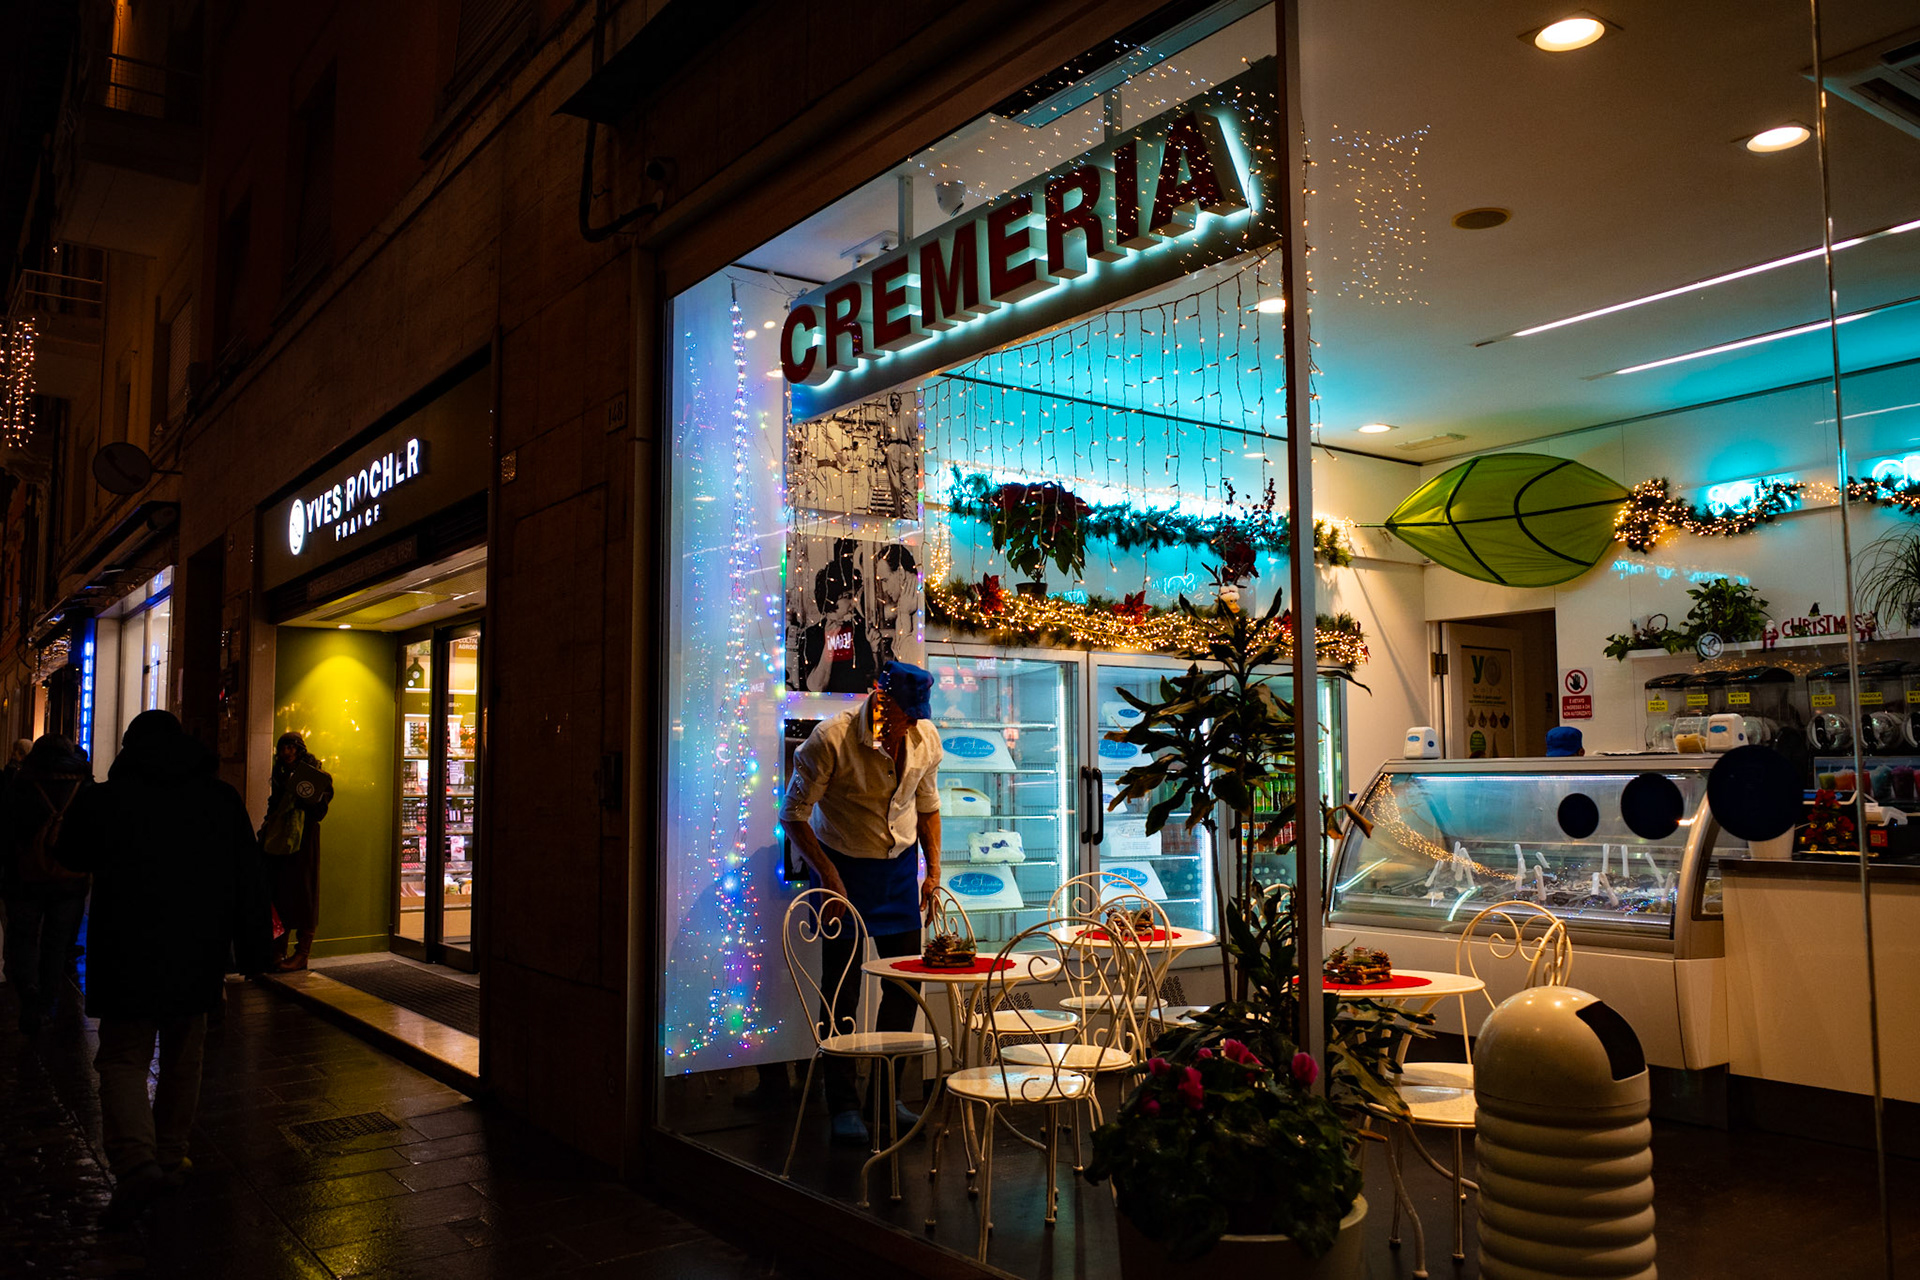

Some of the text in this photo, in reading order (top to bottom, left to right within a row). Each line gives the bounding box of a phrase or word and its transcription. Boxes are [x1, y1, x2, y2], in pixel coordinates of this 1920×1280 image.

[779, 111, 1248, 384] CREMERIA
[305, 437, 421, 533] YVES ROCHER
[1781, 614, 1863, 637] CHRISTMS
